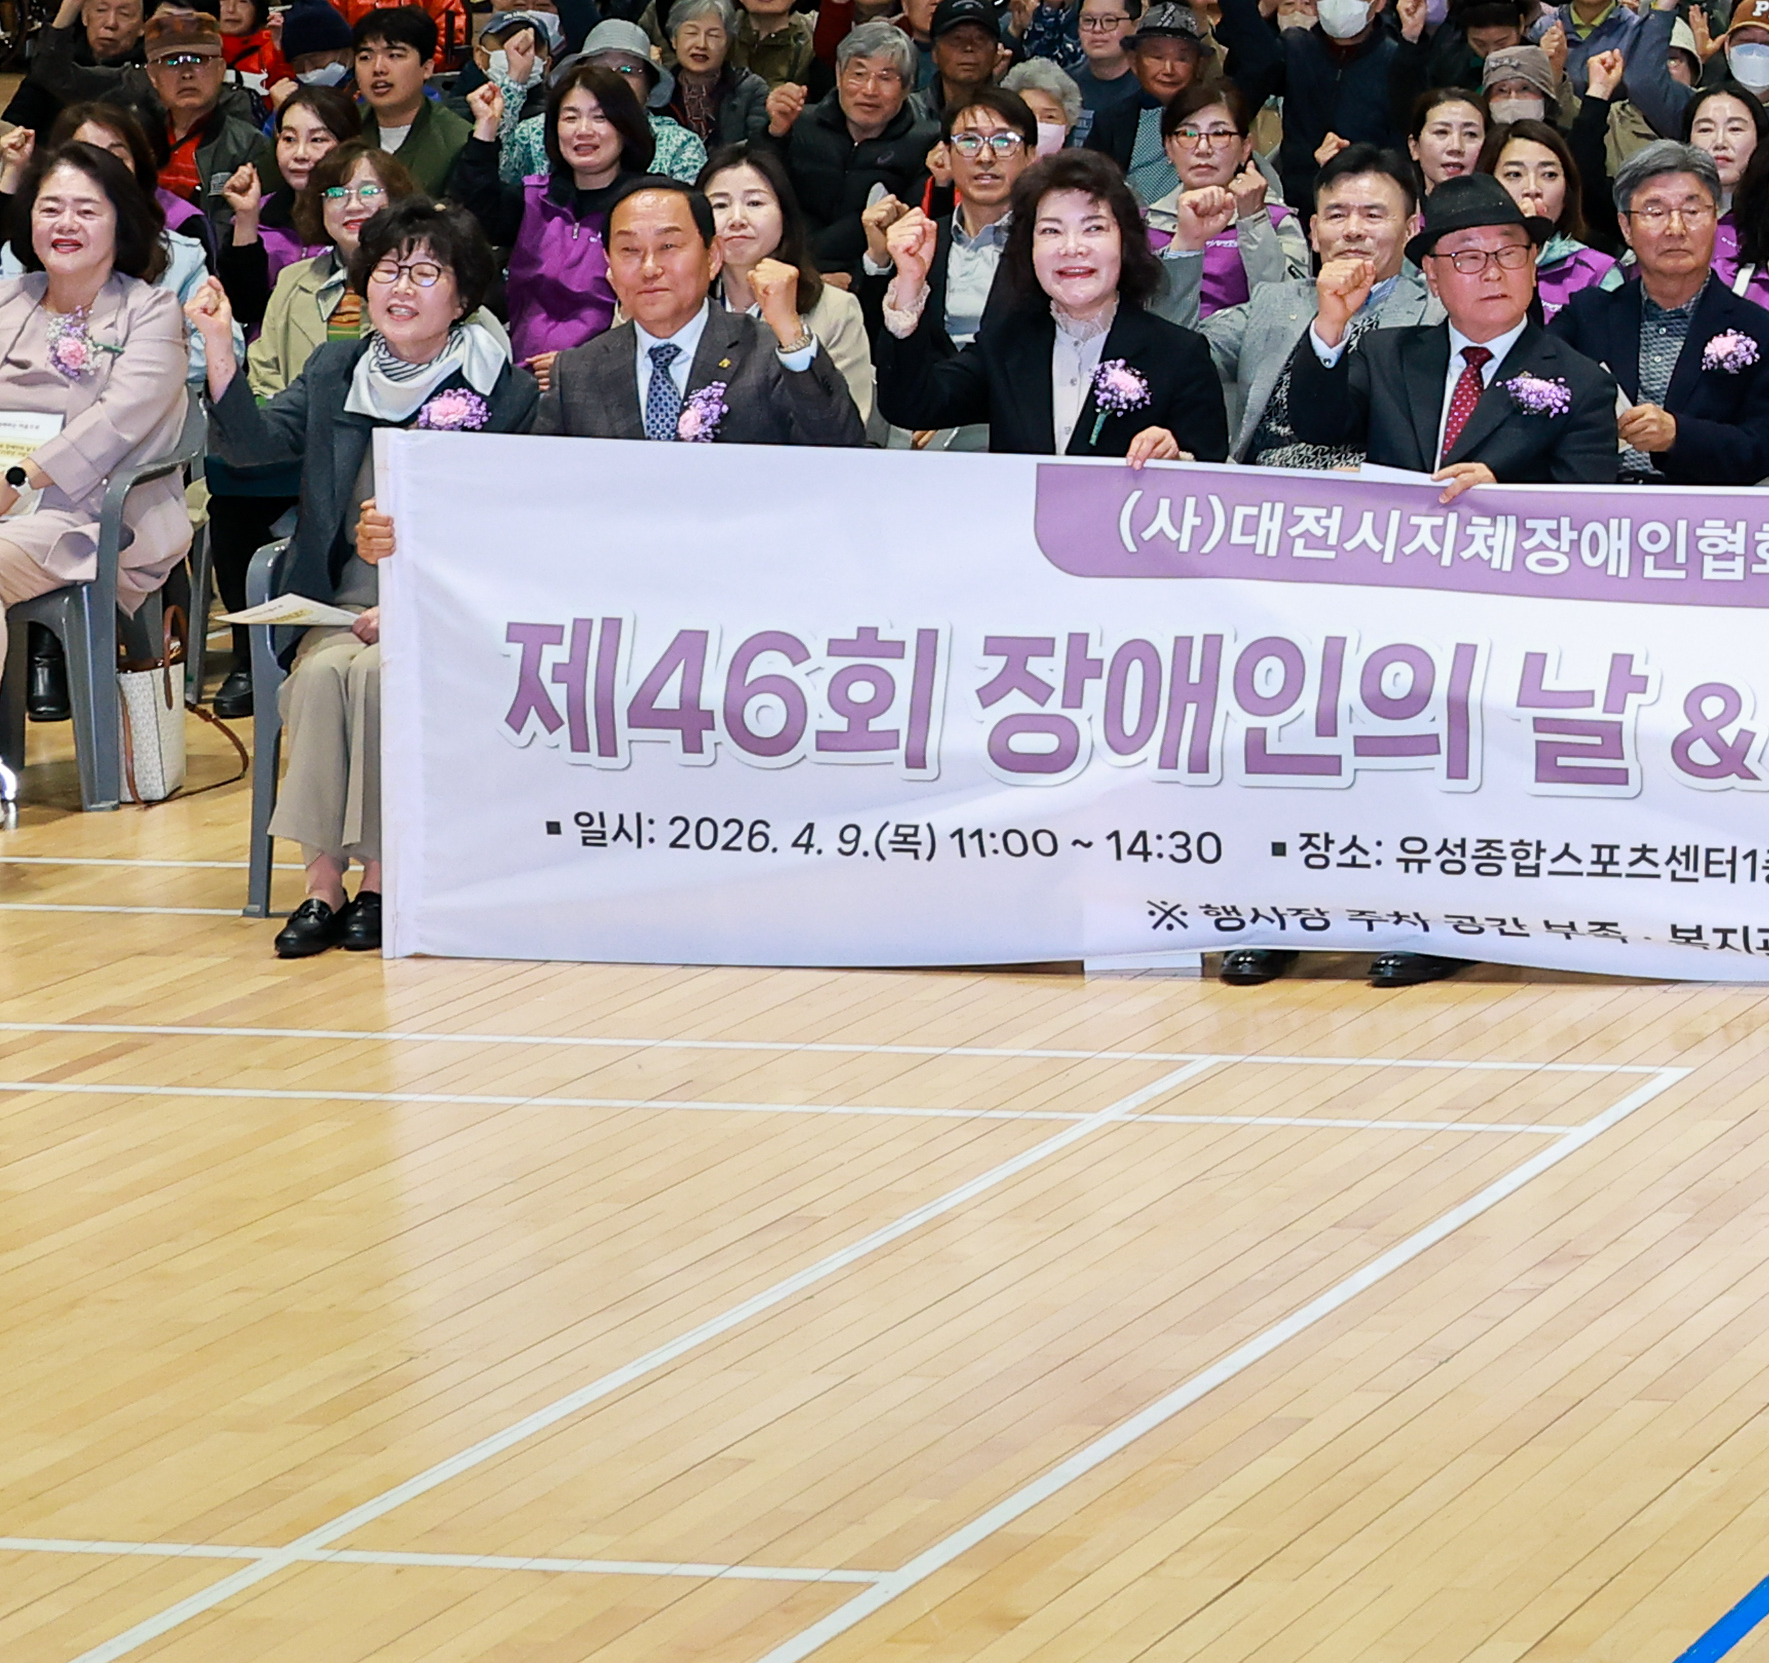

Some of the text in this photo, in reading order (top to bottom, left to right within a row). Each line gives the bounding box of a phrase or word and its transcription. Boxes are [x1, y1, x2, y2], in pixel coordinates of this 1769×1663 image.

[504, 616, 938, 772] 제46회
[974, 630, 1478, 783] 장애인의
[1516, 650, 1649, 788] 날
[1670, 681, 1759, 782] &
[574, 812, 654, 848] 일시:
[669, 816, 777, 853] 2026.
[791, 823, 822, 855] 4.
[838, 821, 936, 862] 9.(목)
[950, 828, 1058, 858] 11:00
[1106, 830, 1221, 864] 14:30
[1299, 832, 1382, 869] 장소:
